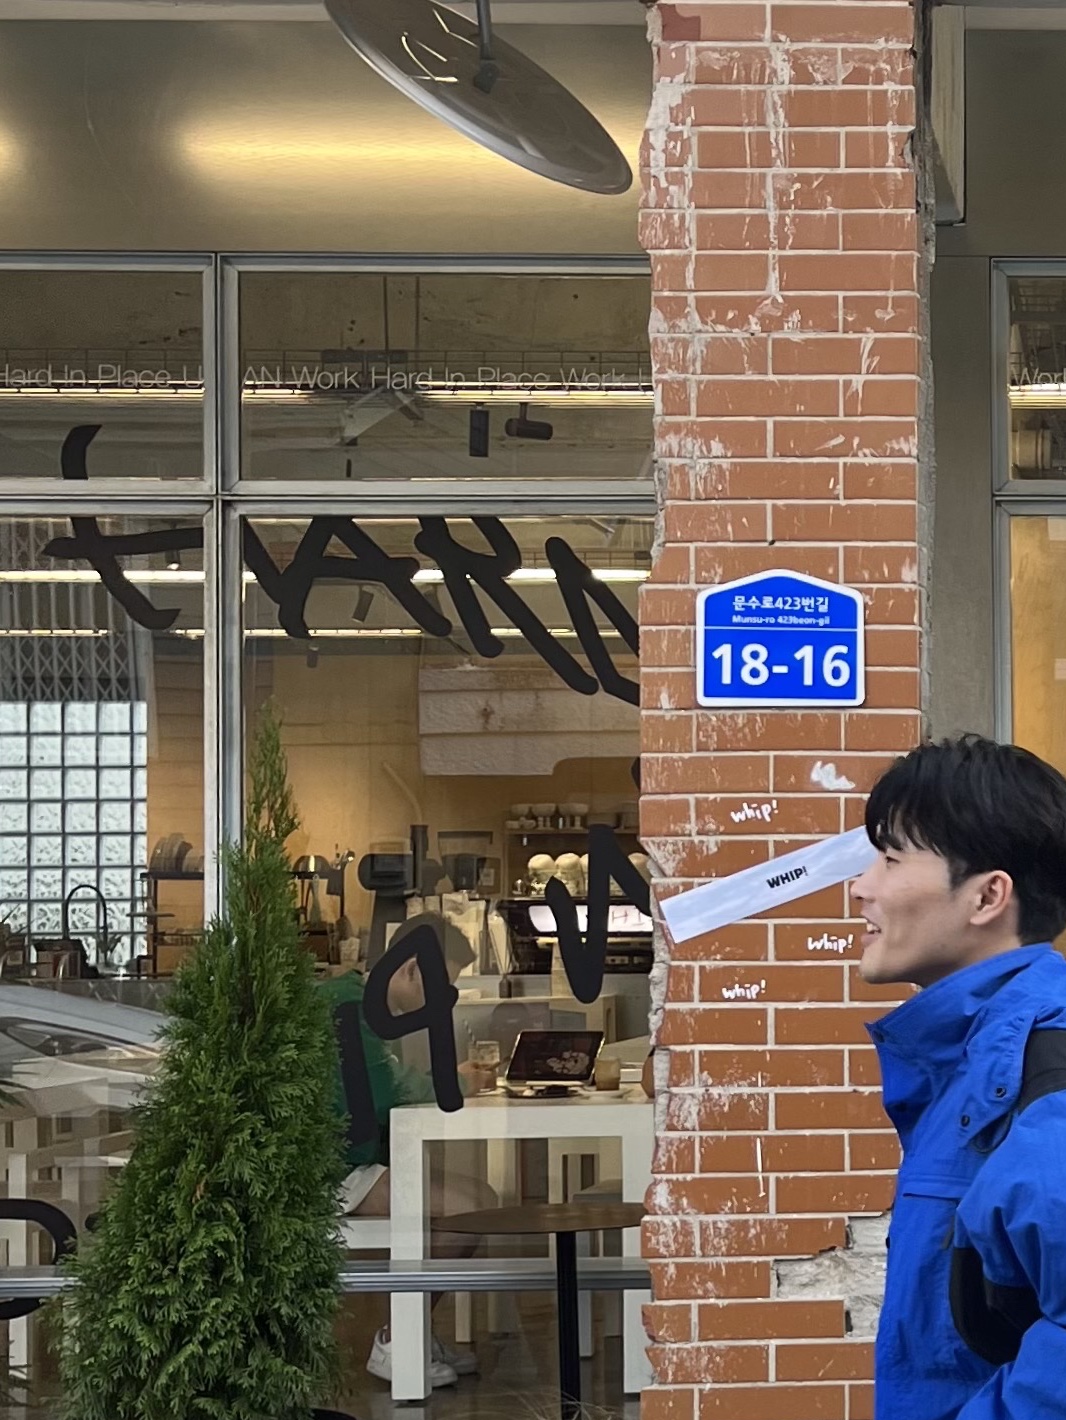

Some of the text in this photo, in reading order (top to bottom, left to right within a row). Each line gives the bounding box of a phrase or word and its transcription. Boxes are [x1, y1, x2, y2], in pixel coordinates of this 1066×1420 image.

[64, 364, 86, 387] In
[98, 364, 171, 388] Place
[291, 366, 360, 389] Work
[371, 366, 432, 389] Hard
[445, 367, 466, 389] In
[478, 367, 549, 390] Place
[559, 367, 626, 391] Work
[732, 595, 829, 613] 문수로423번길
[731, 615, 775, 625] Munsu-ro
[711, 642, 851, 688] 18-16
[730, 799, 779, 823] whip!
[766, 865, 808, 889] WHIP!
[807, 932, 854, 954] whip!
[722, 979, 766, 1000] whip!
